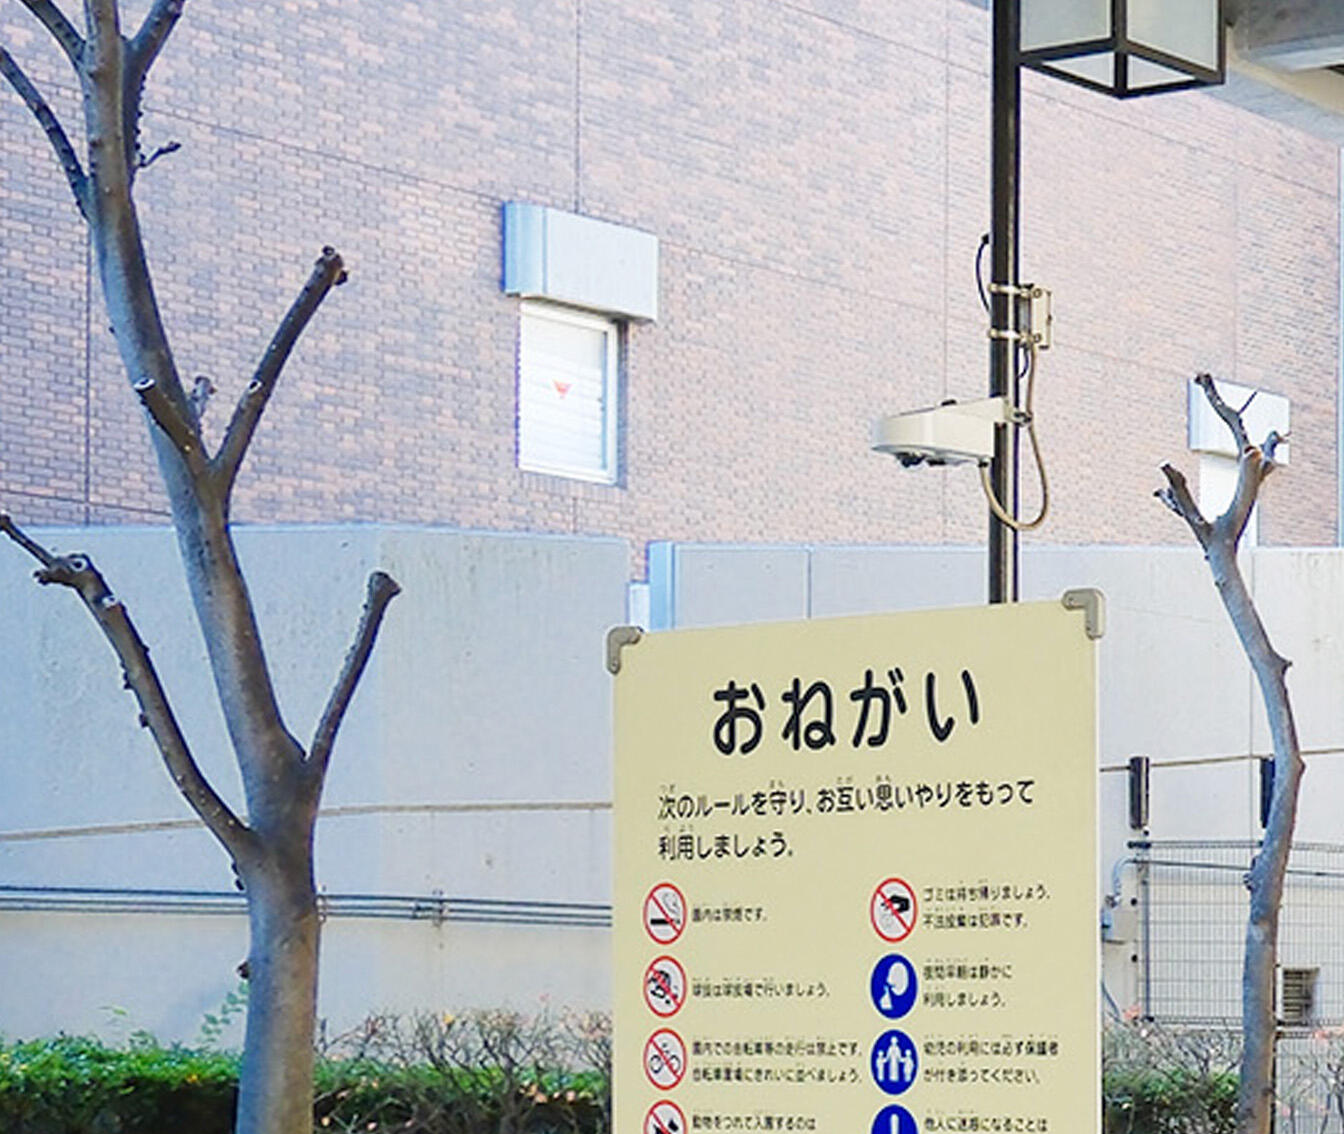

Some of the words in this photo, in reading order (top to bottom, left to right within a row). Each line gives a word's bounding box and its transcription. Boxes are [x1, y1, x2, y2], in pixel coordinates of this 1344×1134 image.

[713, 667, 980, 755] おねがい
[657, 779, 1035, 820] 次のルールを守り、お互い思いやりをもって
[657, 830, 793, 860] 利用しましょう。
